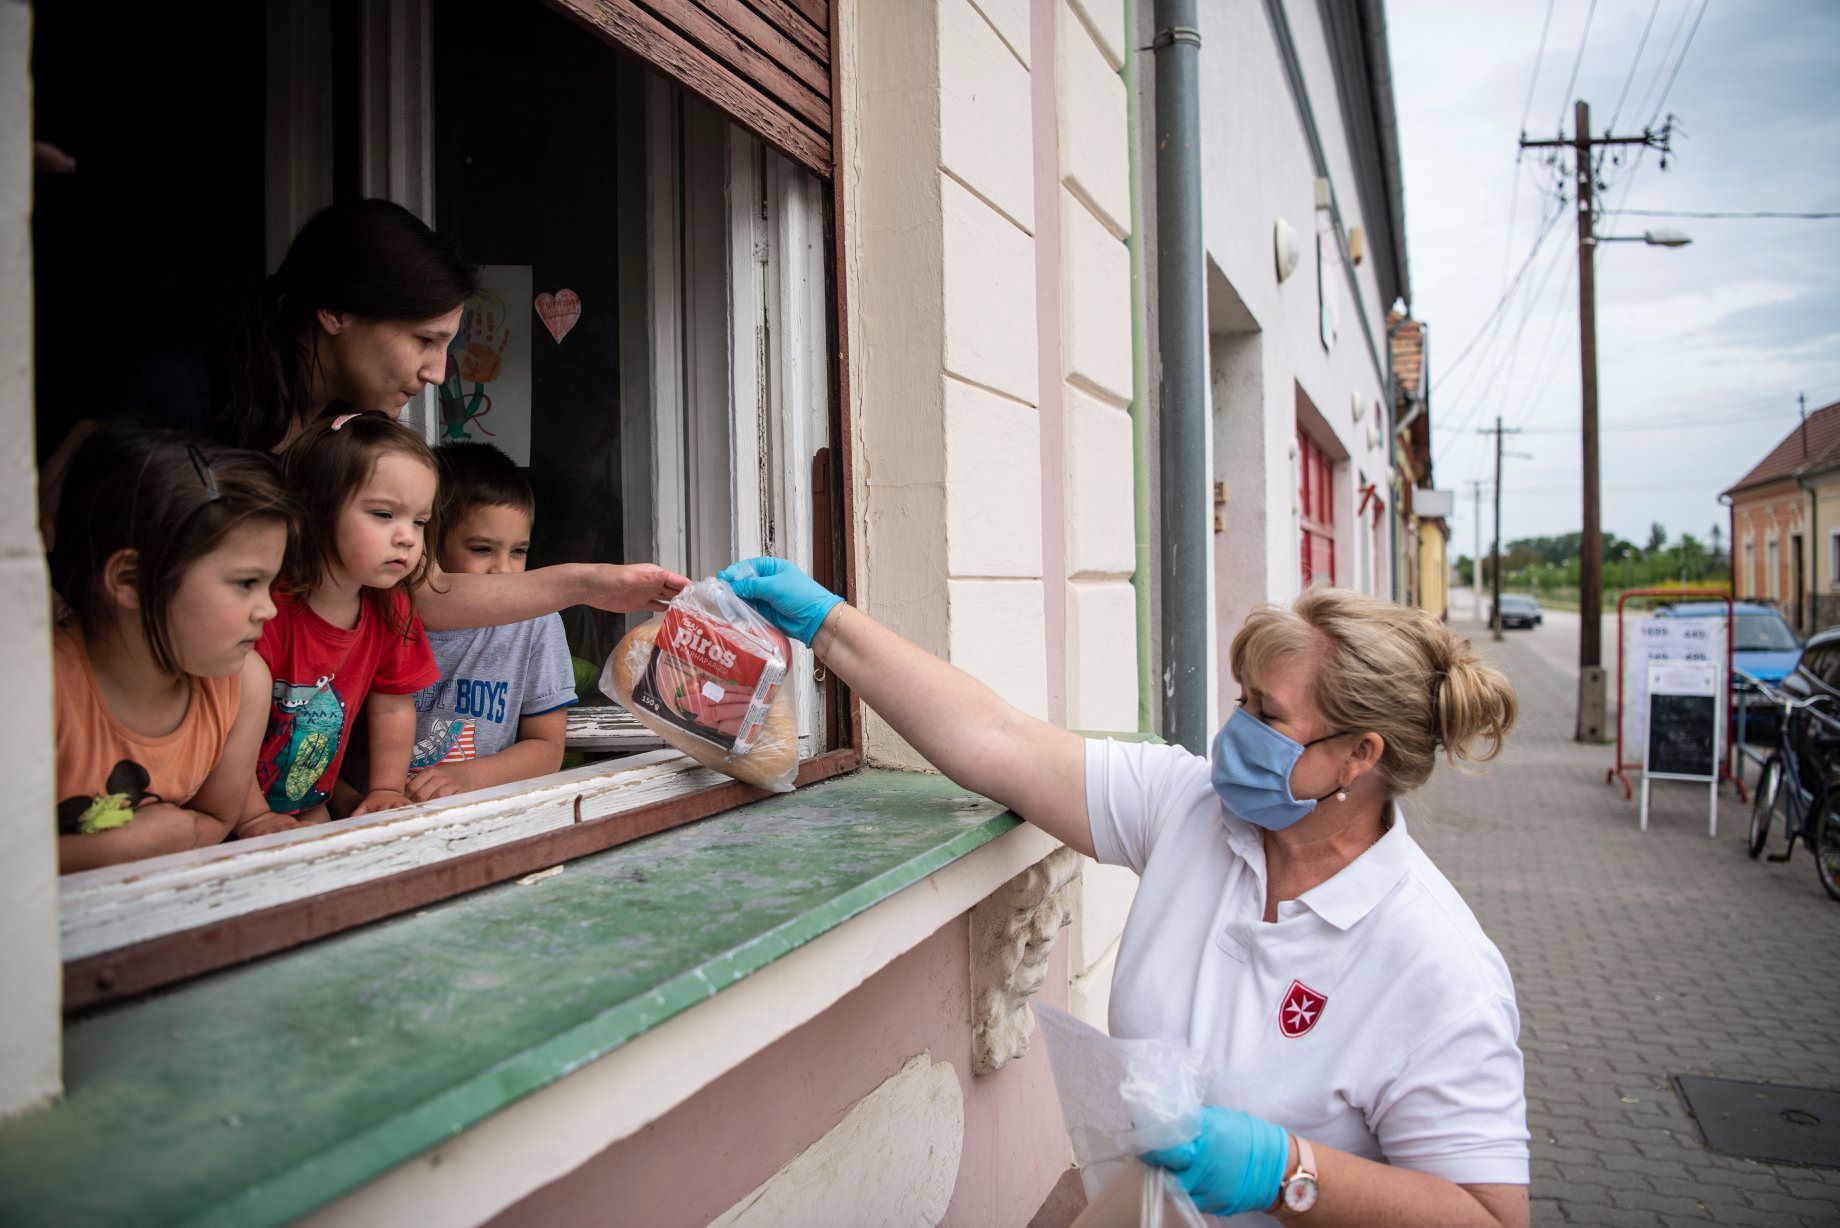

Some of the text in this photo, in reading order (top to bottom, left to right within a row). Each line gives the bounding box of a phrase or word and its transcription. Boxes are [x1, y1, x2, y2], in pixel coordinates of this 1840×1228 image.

[671, 626, 736, 668] piros
[454, 679, 508, 724] BOYS
[641, 695, 660, 711] 150 g
